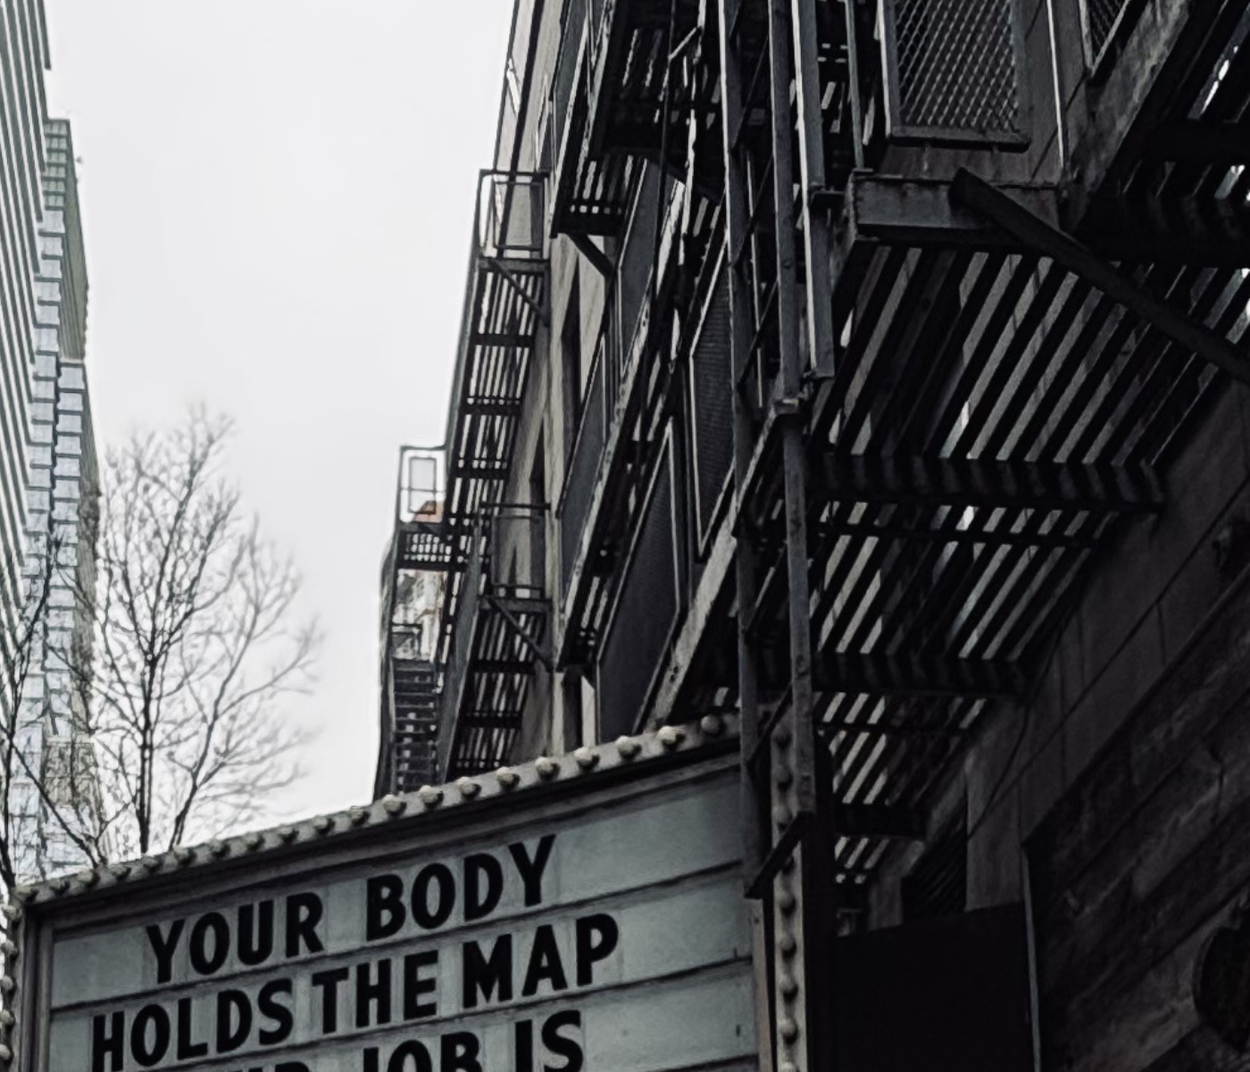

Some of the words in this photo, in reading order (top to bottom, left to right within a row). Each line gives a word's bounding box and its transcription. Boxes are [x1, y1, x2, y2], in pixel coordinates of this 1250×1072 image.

[146, 891, 325, 984] YOUR
[365, 833, 559, 943] BODY
[311, 948, 439, 1035] THE
[461, 912, 620, 1004] MAP
